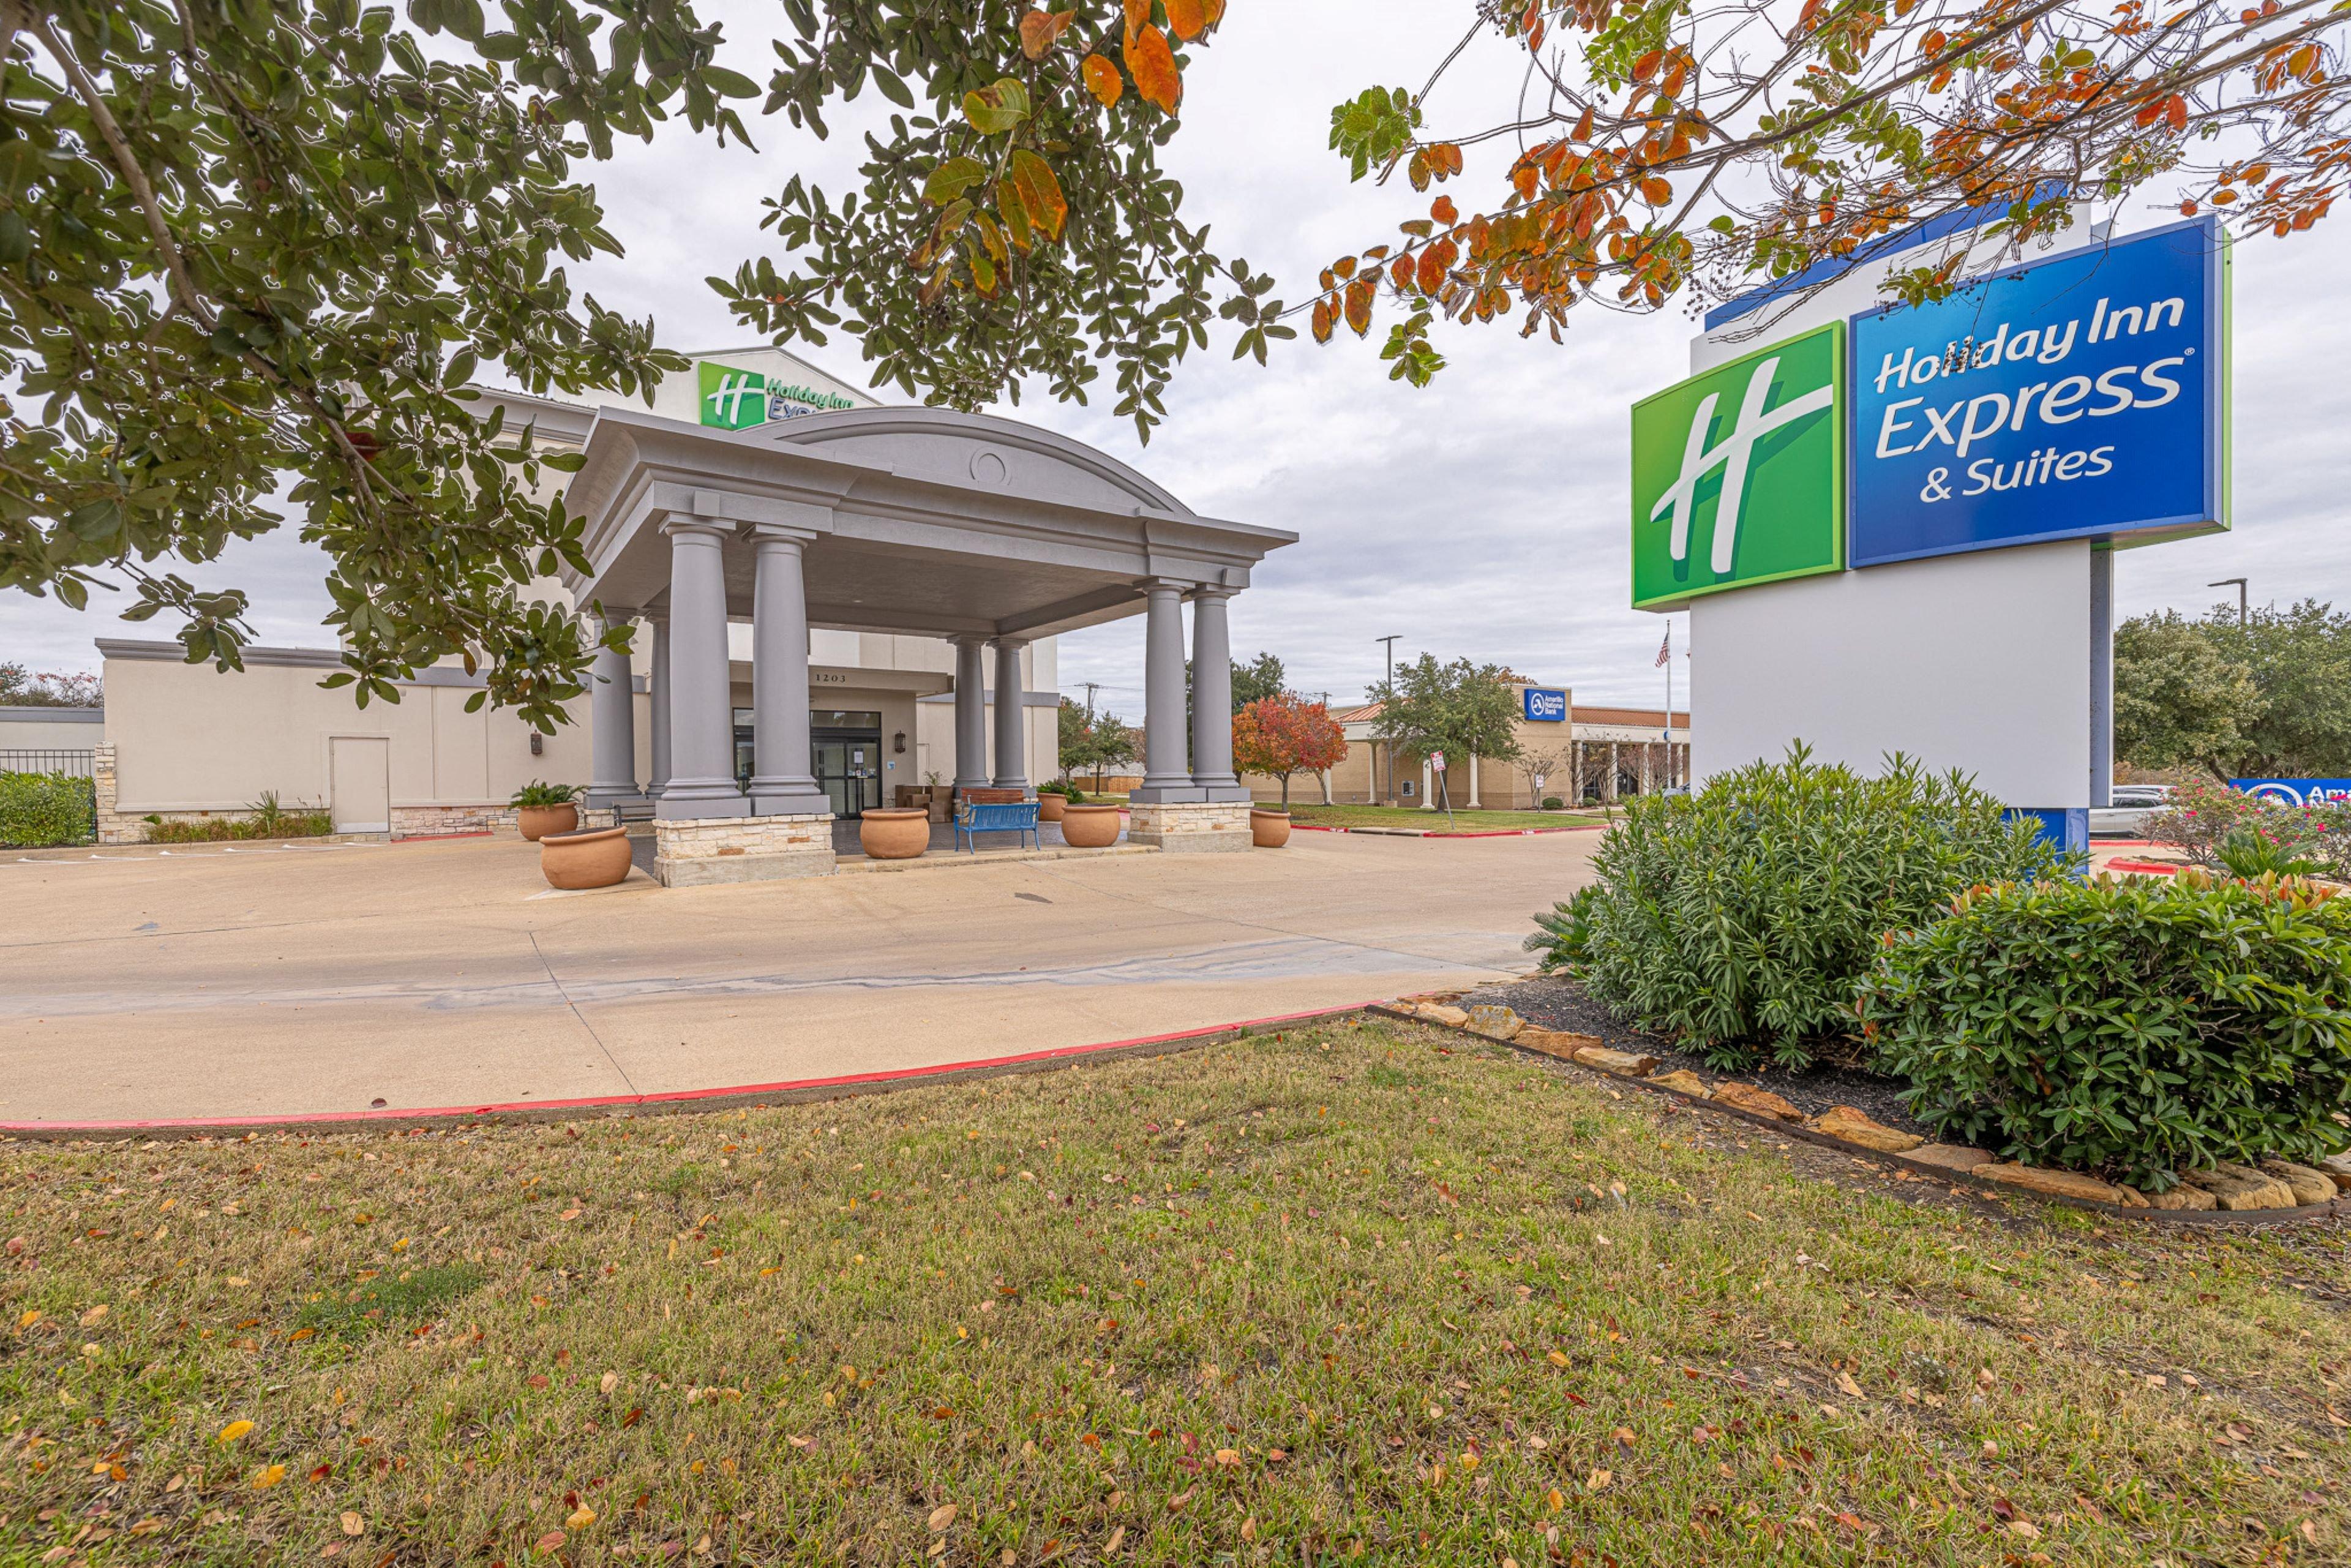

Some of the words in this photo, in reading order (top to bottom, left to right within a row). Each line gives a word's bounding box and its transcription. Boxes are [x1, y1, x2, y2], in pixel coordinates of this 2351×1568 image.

[1873, 323, 2079, 394] Holiday
[2088, 298, 2184, 343] Inn
[767, 378, 829, 410] Holiday
[829, 391, 854, 409] Inn
[1876, 357, 2184, 459] Express
[1650, 357, 1833, 574] H
[1920, 467, 1952, 503] &
[1962, 446, 2115, 495] Suites
[816, 674, 846, 683] 1203
